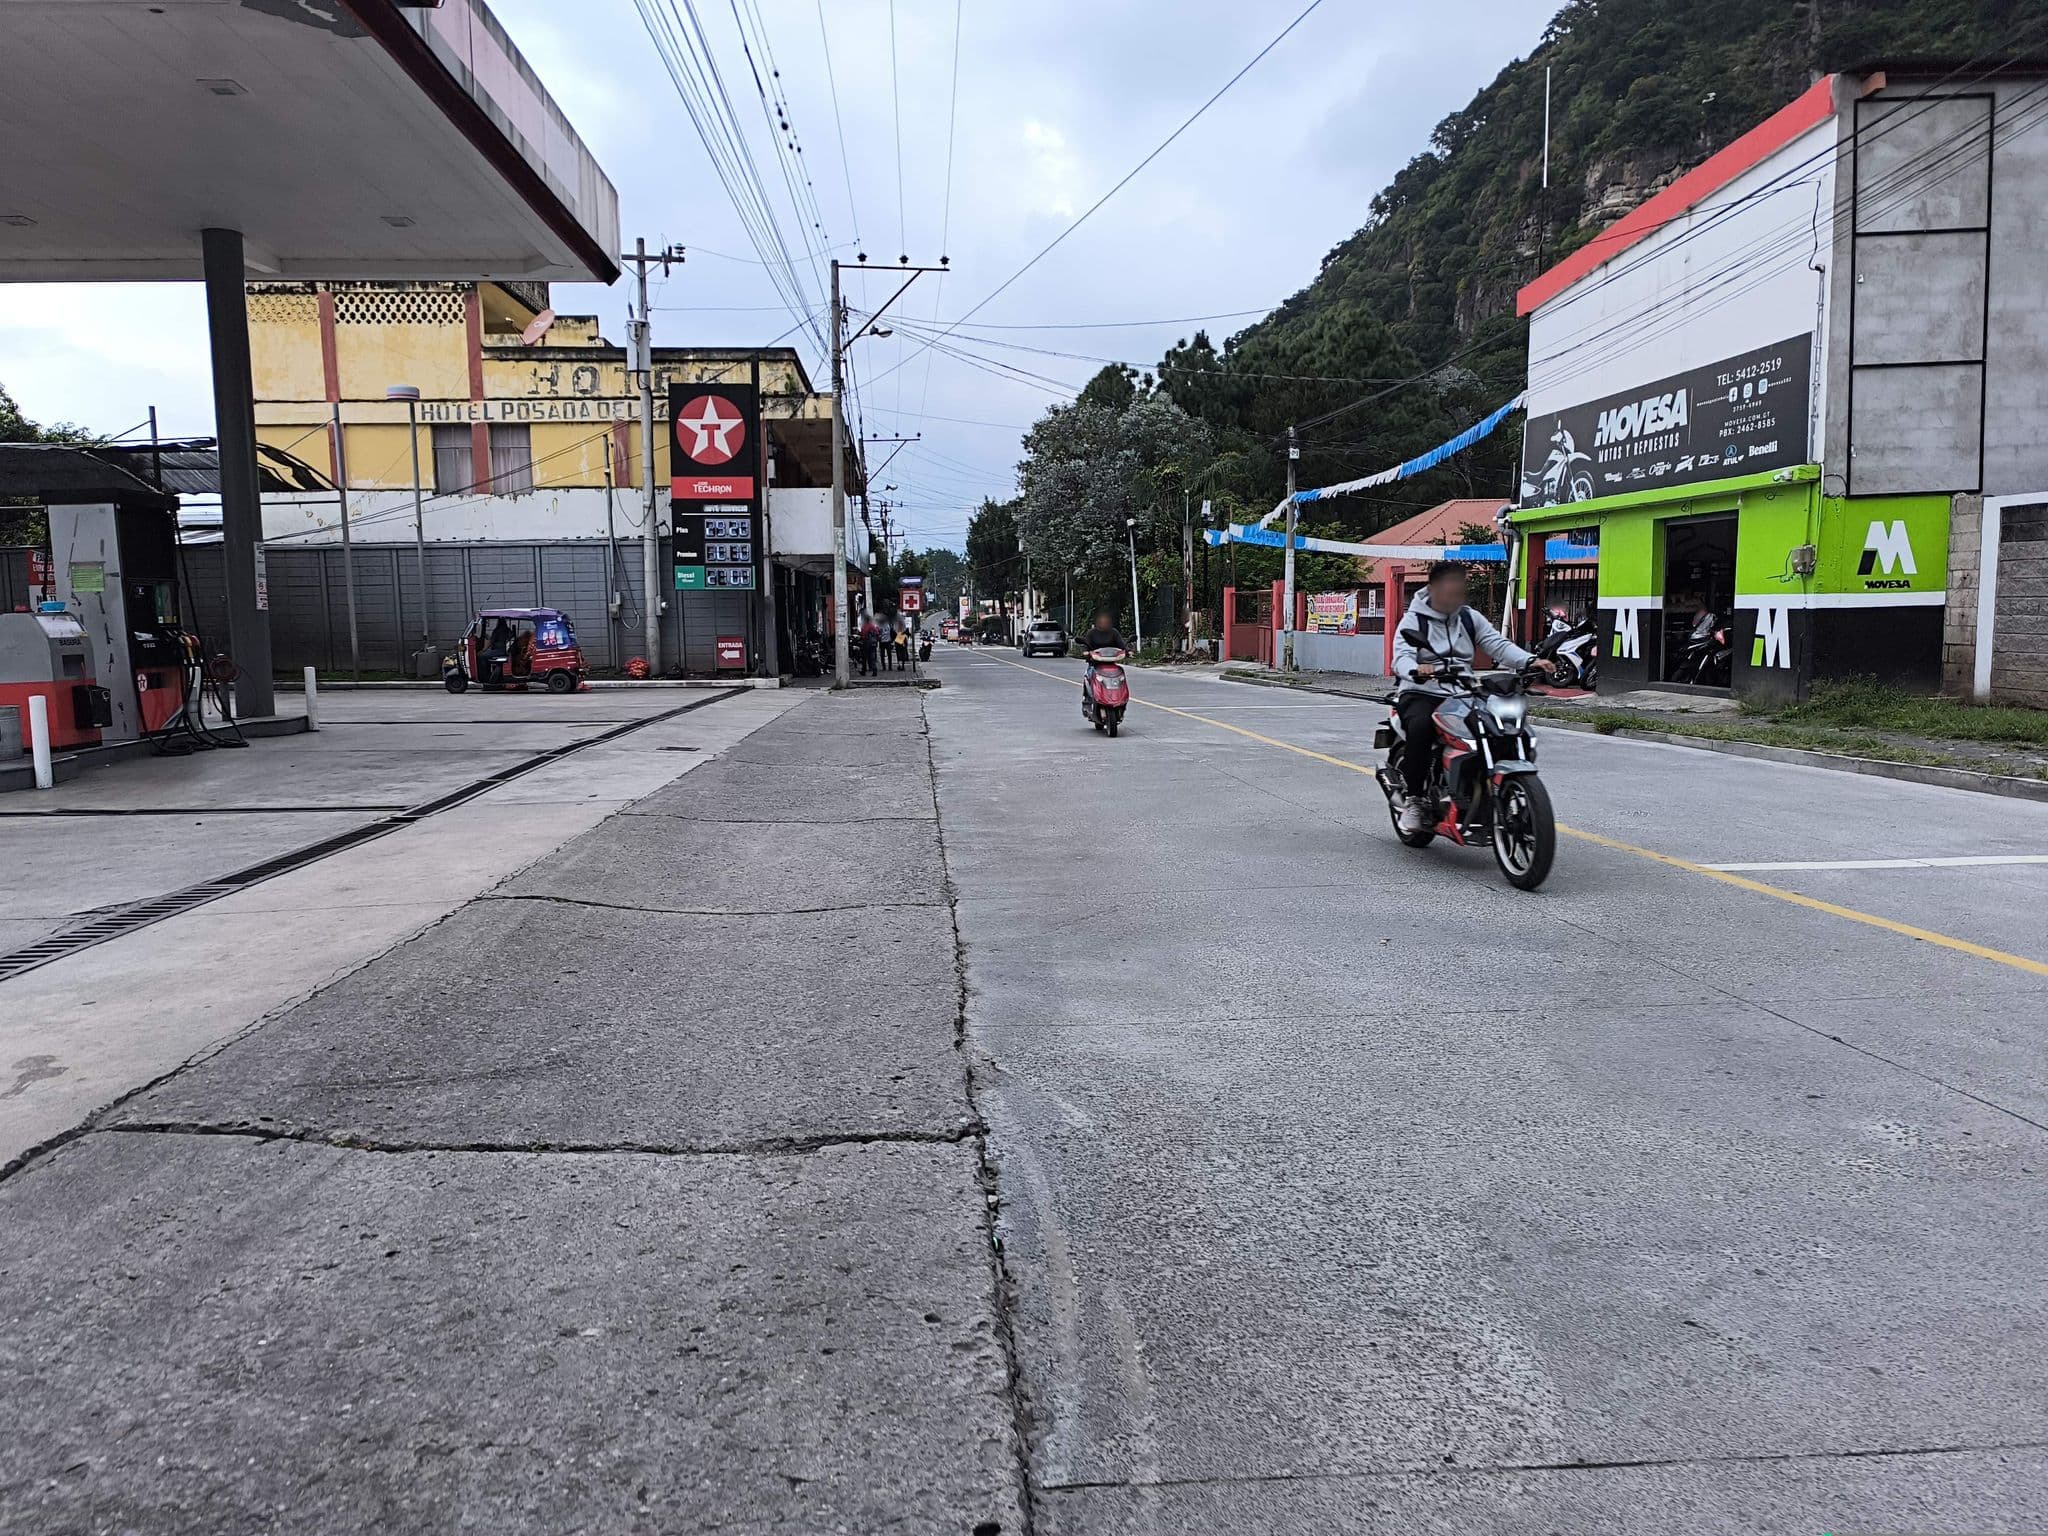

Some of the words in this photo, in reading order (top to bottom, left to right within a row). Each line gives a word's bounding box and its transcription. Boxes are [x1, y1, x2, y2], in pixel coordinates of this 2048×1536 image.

[1717, 372, 1734, 386] TEL:
[1736, 357, 1782, 381] 5412-2519
[421, 402, 494, 420] HOTEL
[501, 401, 592, 419] POSADA
[1594, 388, 1688, 447] MOVESA
[1719, 427, 1735, 438] PBX:
[1737, 417, 1776, 434] 2462-8585
[1598, 445, 1622, 463] MOTOS
[1625, 444, 1631, 458] Y
[1634, 432, 1680, 455] REPUESTOS
[1749, 440, 1778, 457] Benelli
[693, 484, 732, 494] TECHRON
[678, 571, 695, 579] Diesel
[1864, 579, 1911, 589] MOVESA
